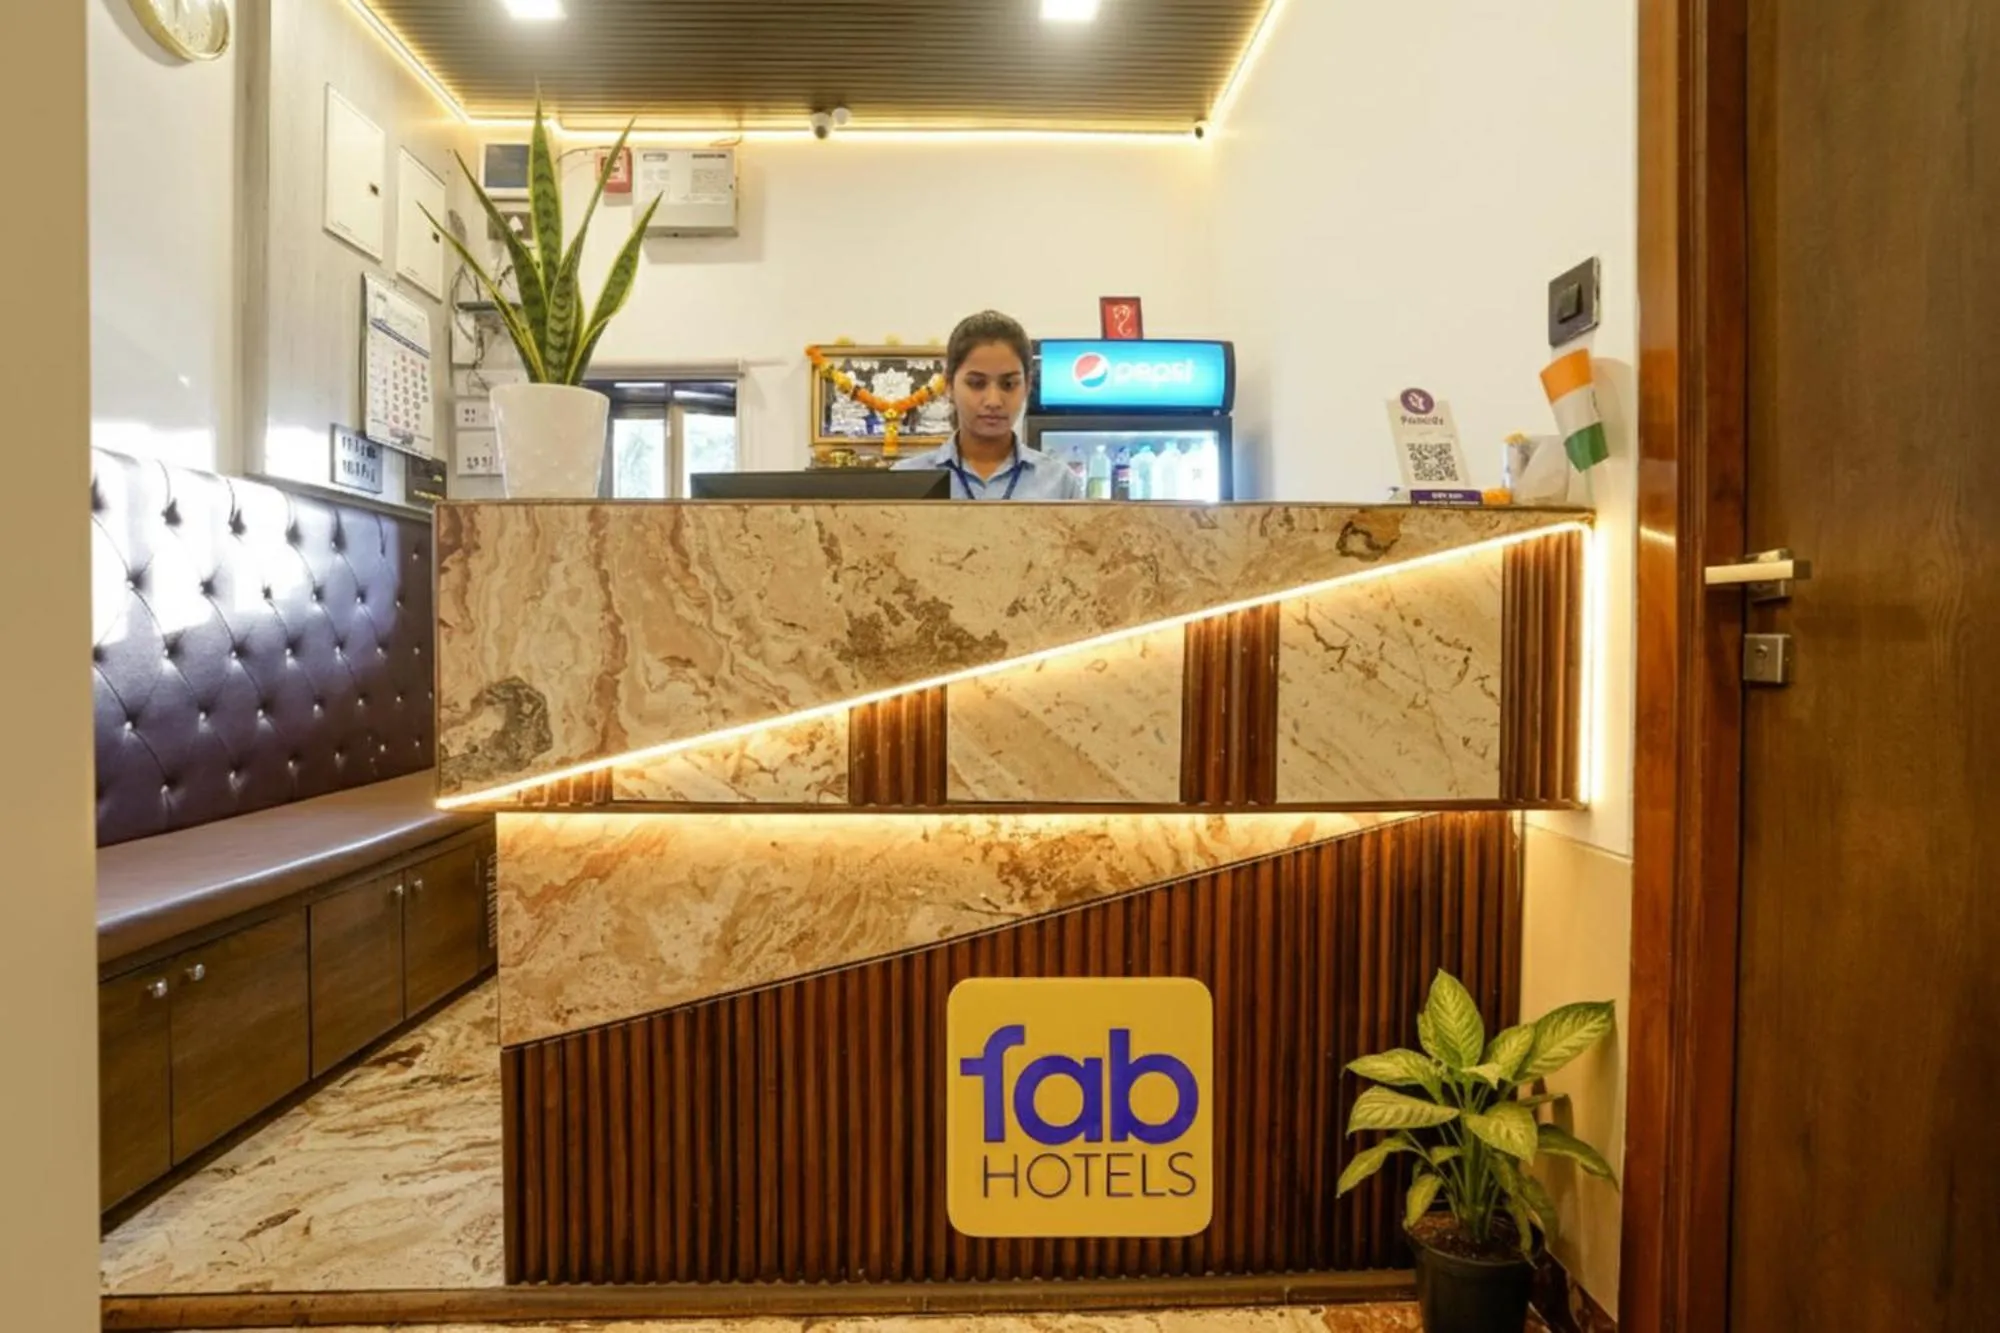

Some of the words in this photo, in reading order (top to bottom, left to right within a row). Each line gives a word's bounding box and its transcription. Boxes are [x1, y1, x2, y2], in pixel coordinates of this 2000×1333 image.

[1113, 358, 1194, 389] pepsi
[960, 1024, 1199, 1145] fab
[983, 1152, 1197, 1198] HOTELS
